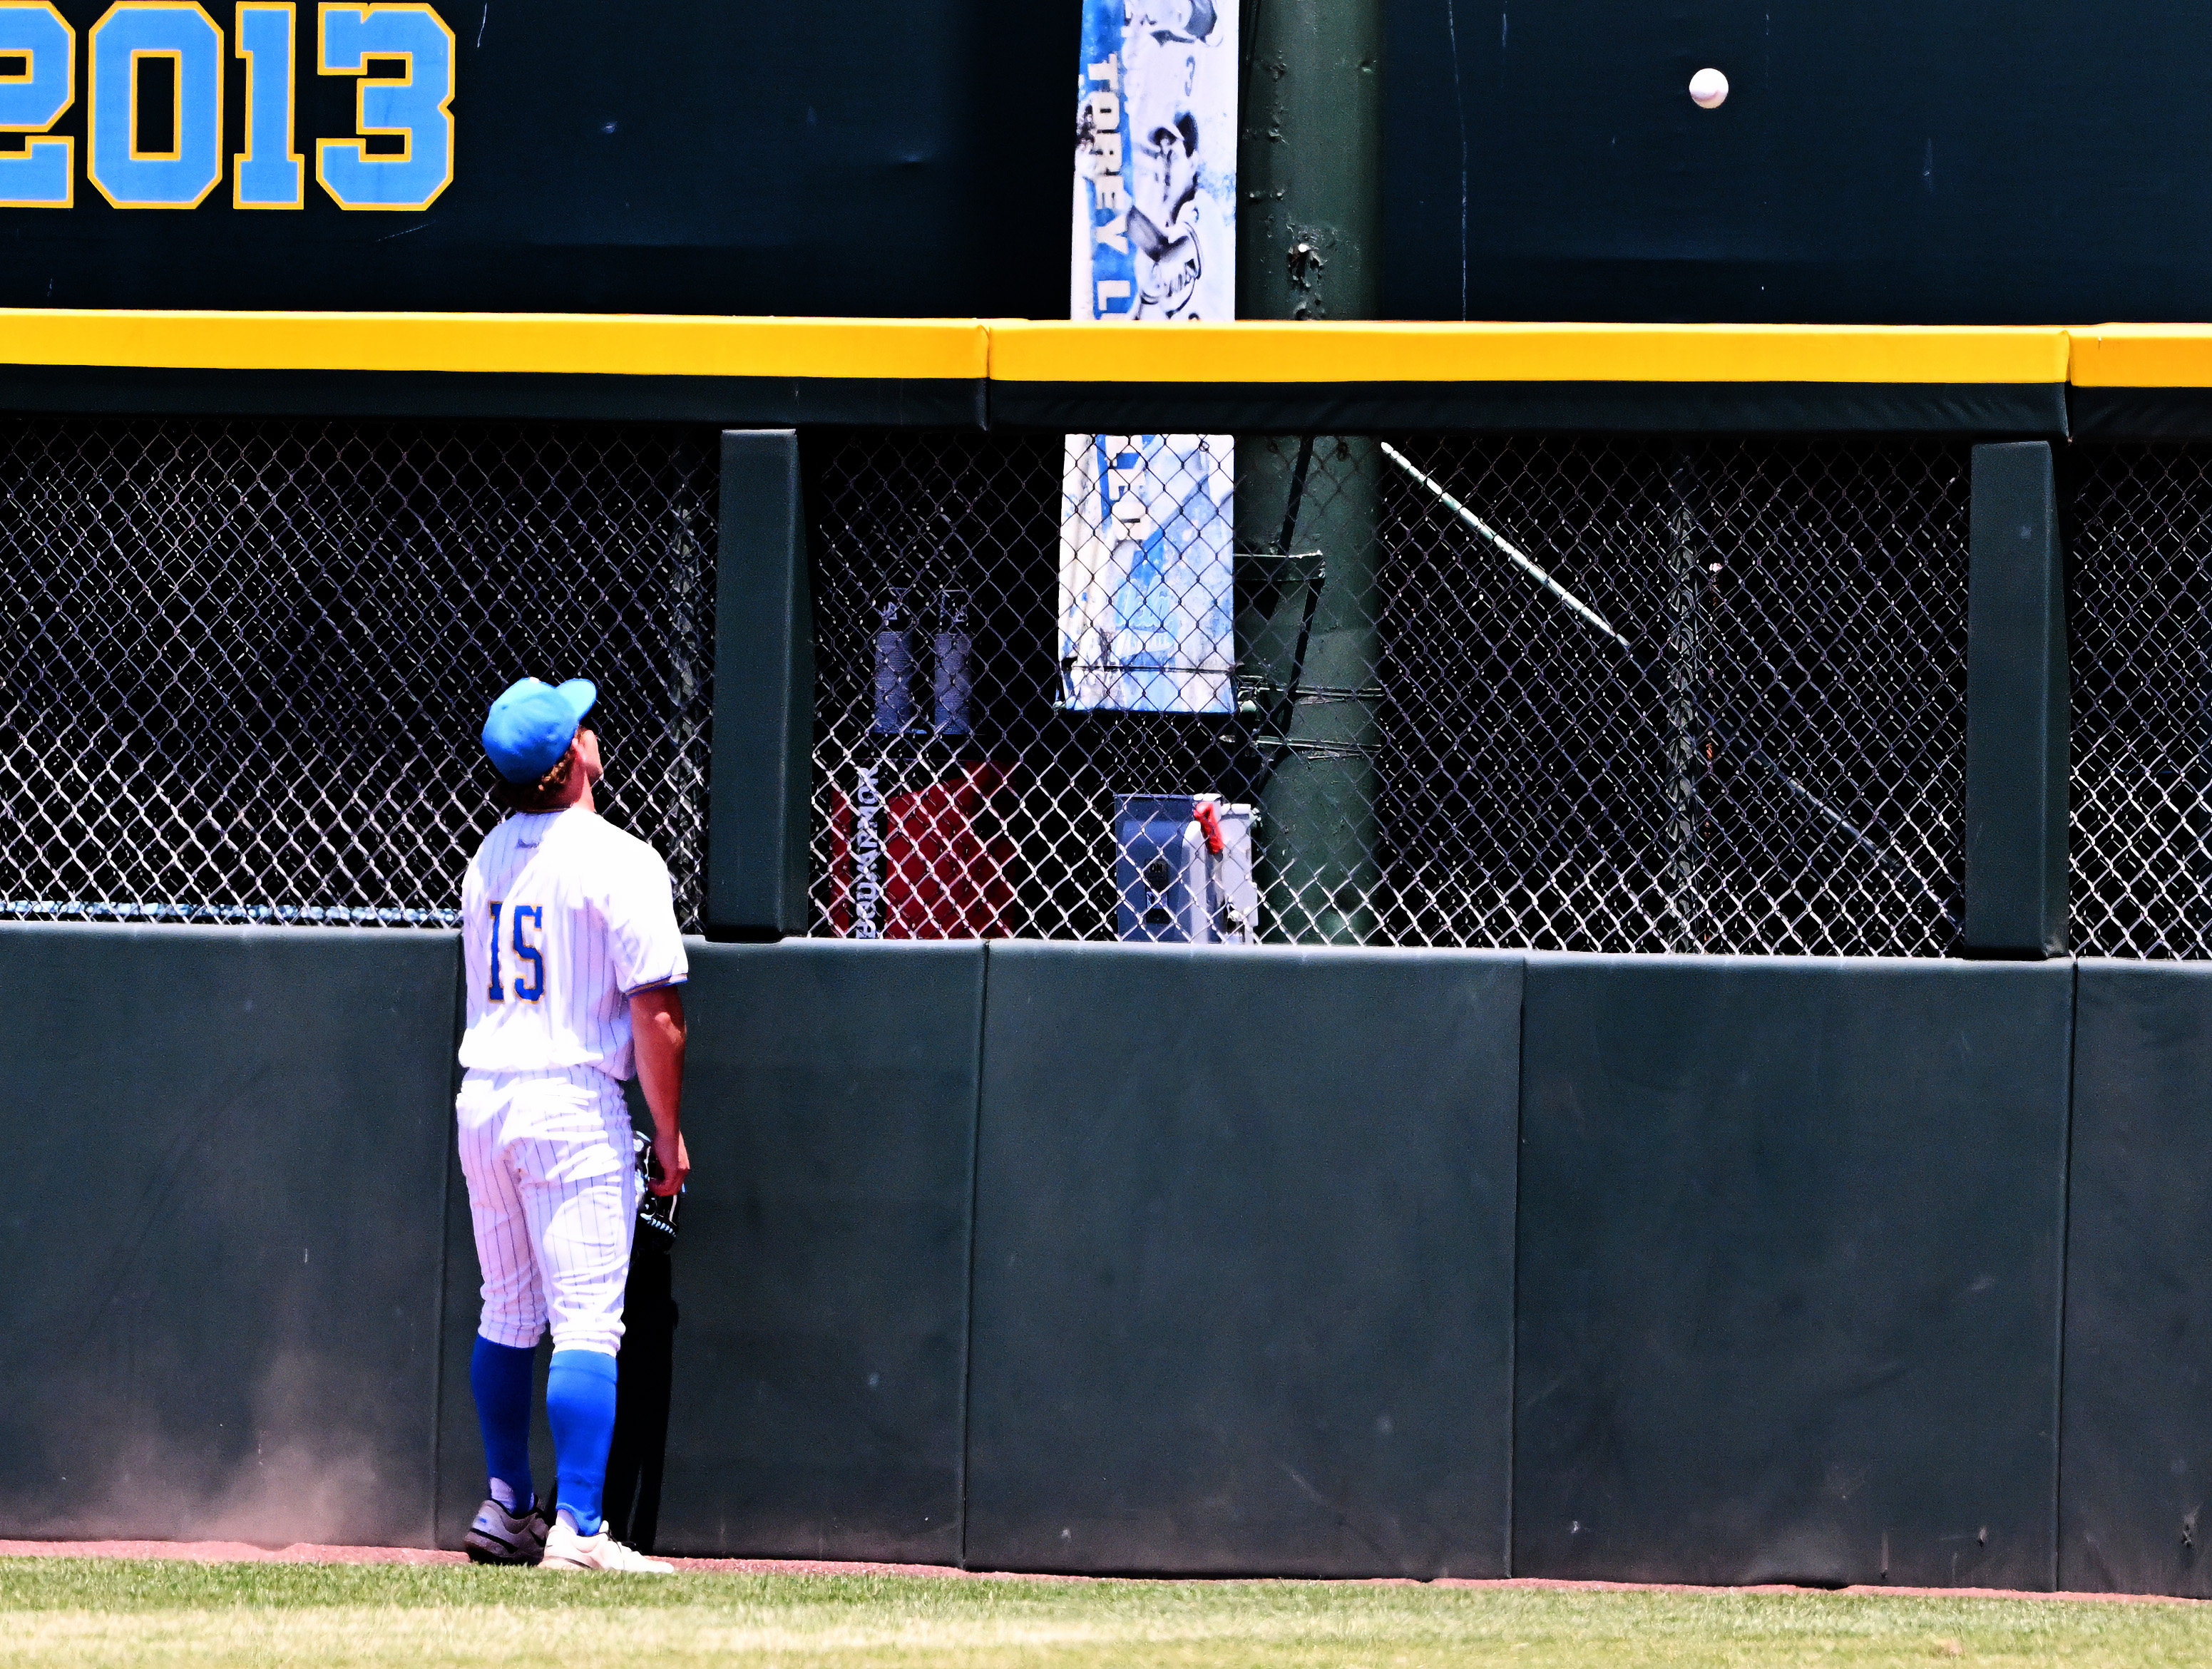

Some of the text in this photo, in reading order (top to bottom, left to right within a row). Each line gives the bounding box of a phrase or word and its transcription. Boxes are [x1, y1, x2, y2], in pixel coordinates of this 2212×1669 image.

[0, 0, 455, 211] 2013
[1087, 53, 1128, 255] TOREY
[488, 900, 546, 1004] 15
